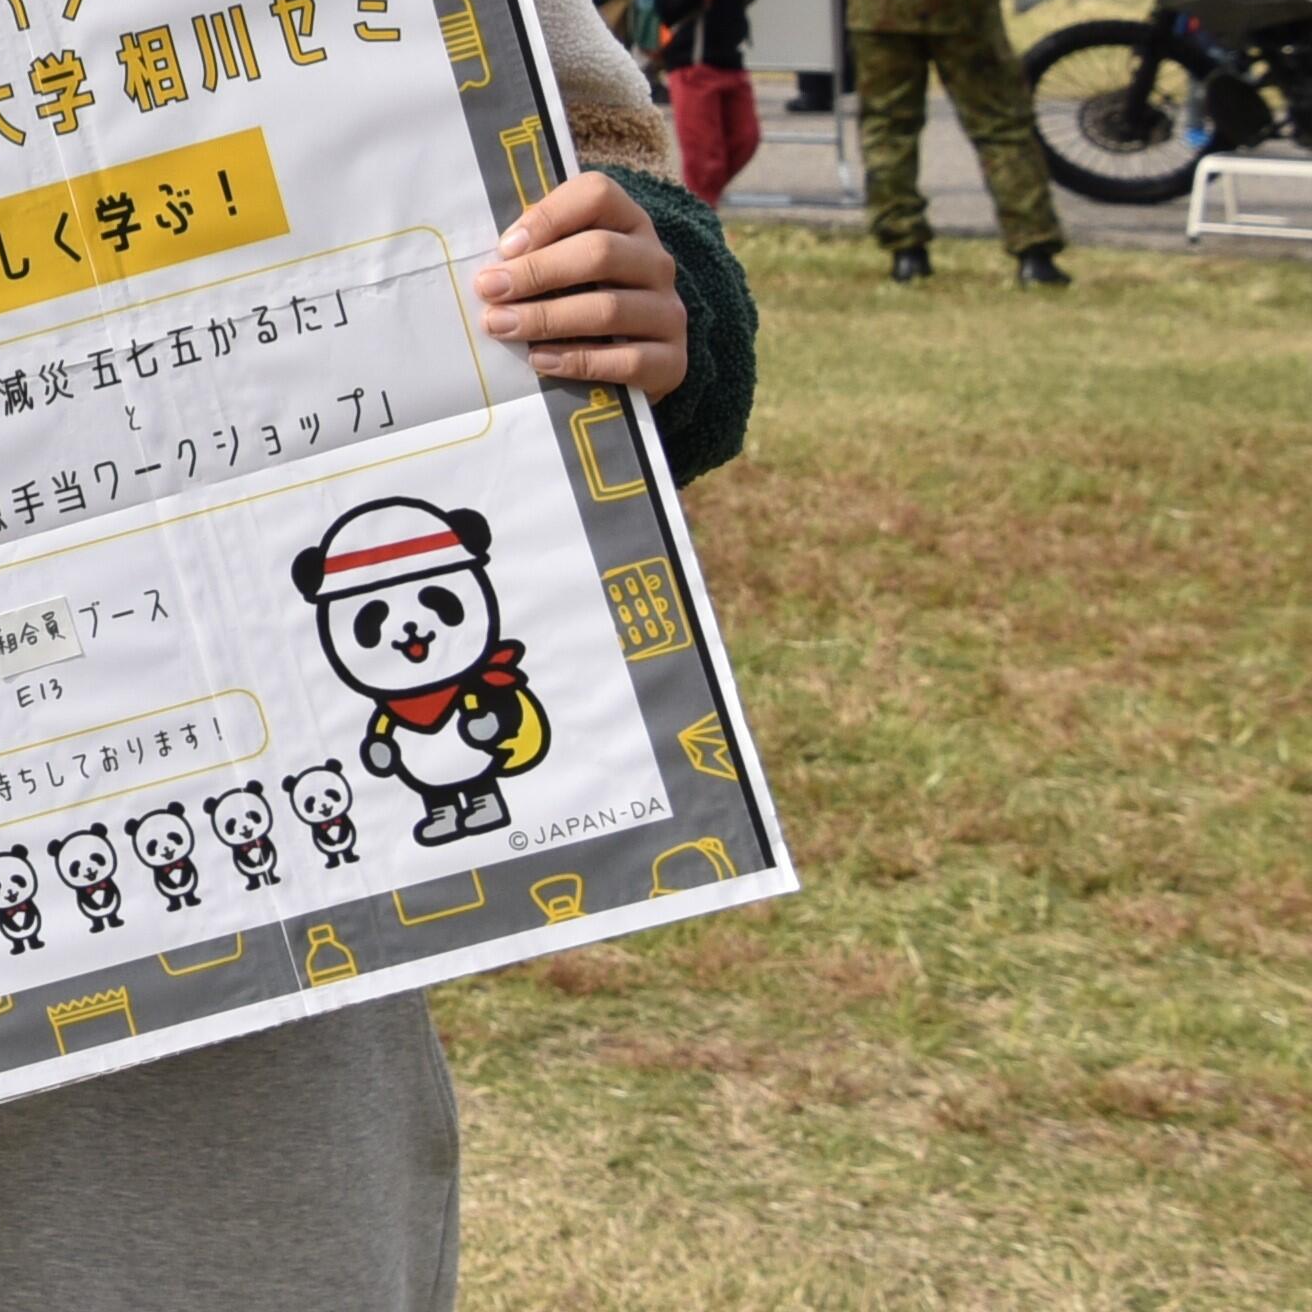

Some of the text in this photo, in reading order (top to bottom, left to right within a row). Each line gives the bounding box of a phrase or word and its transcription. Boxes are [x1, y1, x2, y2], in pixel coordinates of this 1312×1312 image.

[123, 403, 143, 432] と
[78, 588, 170, 639] ブース
[16, 678, 64, 709] E13
